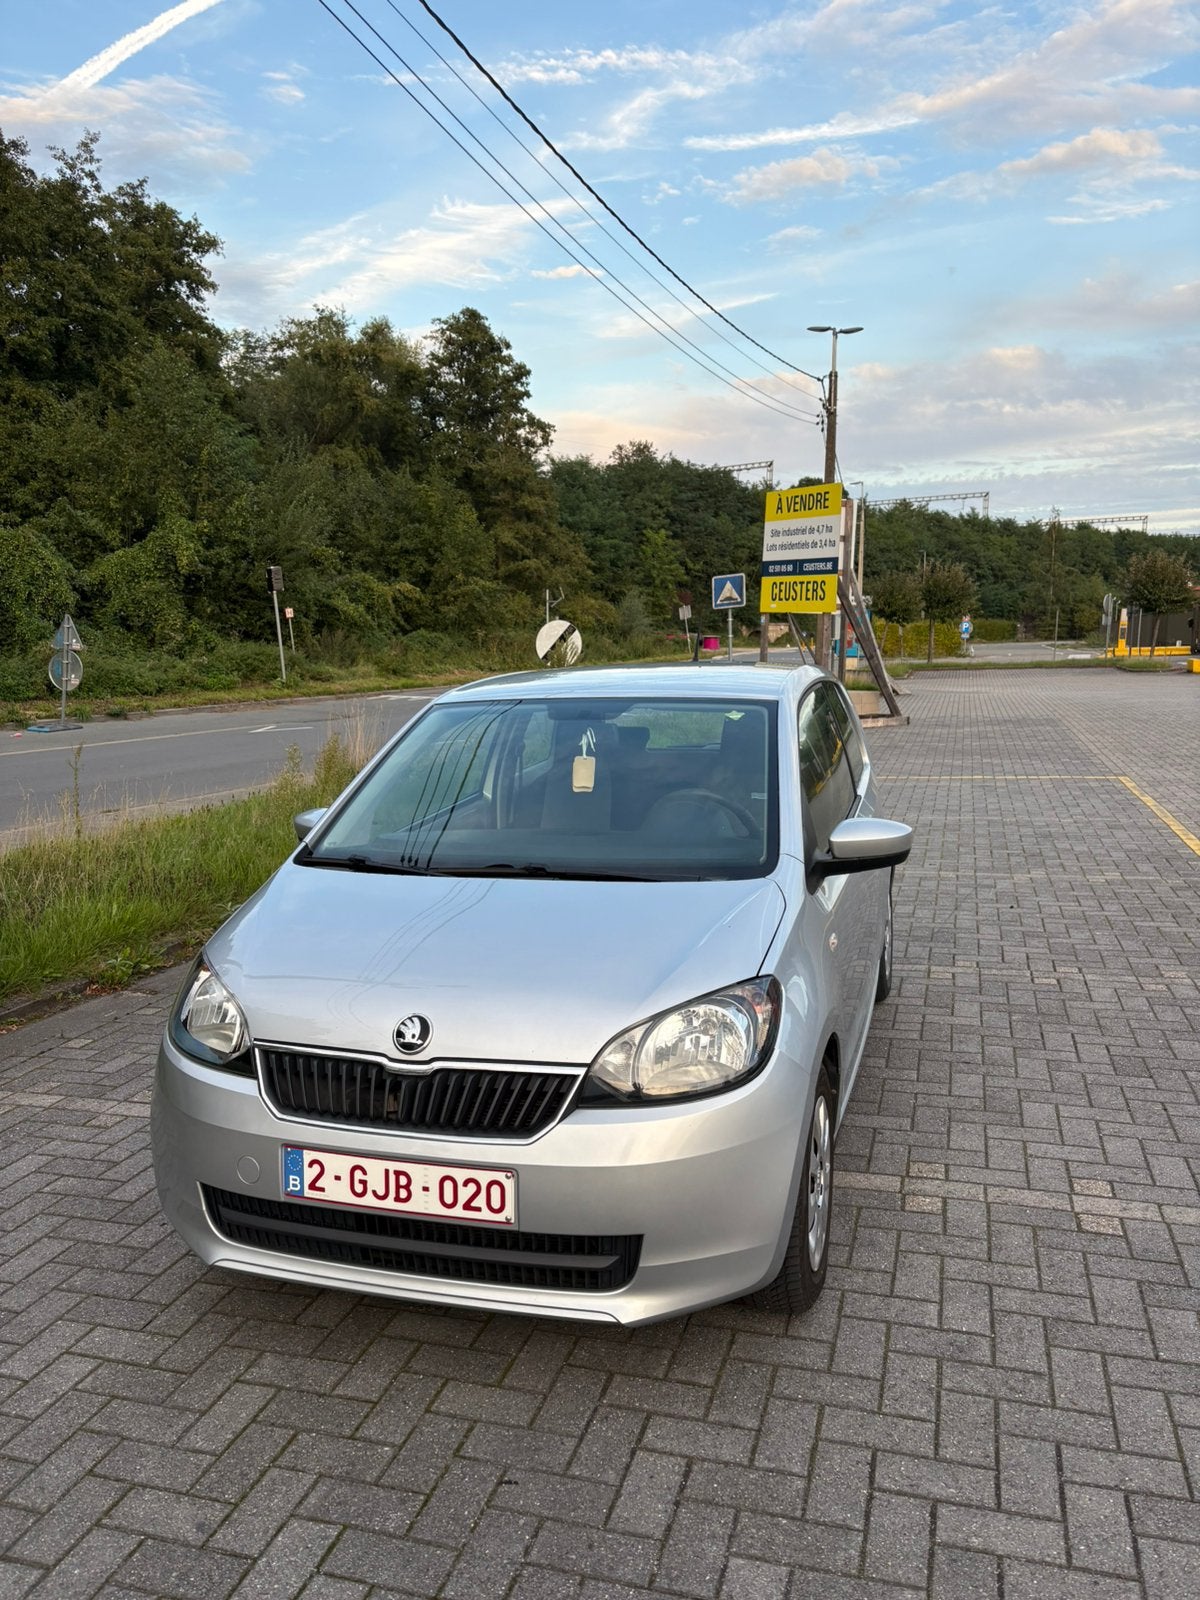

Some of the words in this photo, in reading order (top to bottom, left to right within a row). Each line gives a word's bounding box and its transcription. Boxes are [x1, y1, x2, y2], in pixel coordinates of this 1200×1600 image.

[776, 494, 783, 514] À
[786, 491, 830, 513] VENDRE
[770, 529, 781, 537] Site
[782, 526, 807, 536] industriel
[808, 526, 815, 534] de
[816, 525, 824, 534] 4,7
[826, 524, 833, 533] ha
[766, 543, 777, 552] Lots
[778, 540, 809, 550] résidentiels
[811, 540, 818, 548] de
[819, 539, 827, 549] 3,4
[829, 538, 836, 547] ha
[803, 562, 833, 571] CEUSTERS.BE
[771, 580, 826, 601] CEUSTERS
[289, 1175, 300, 1191] B
[308, 1159, 506, 1214] 2-GJB-020
